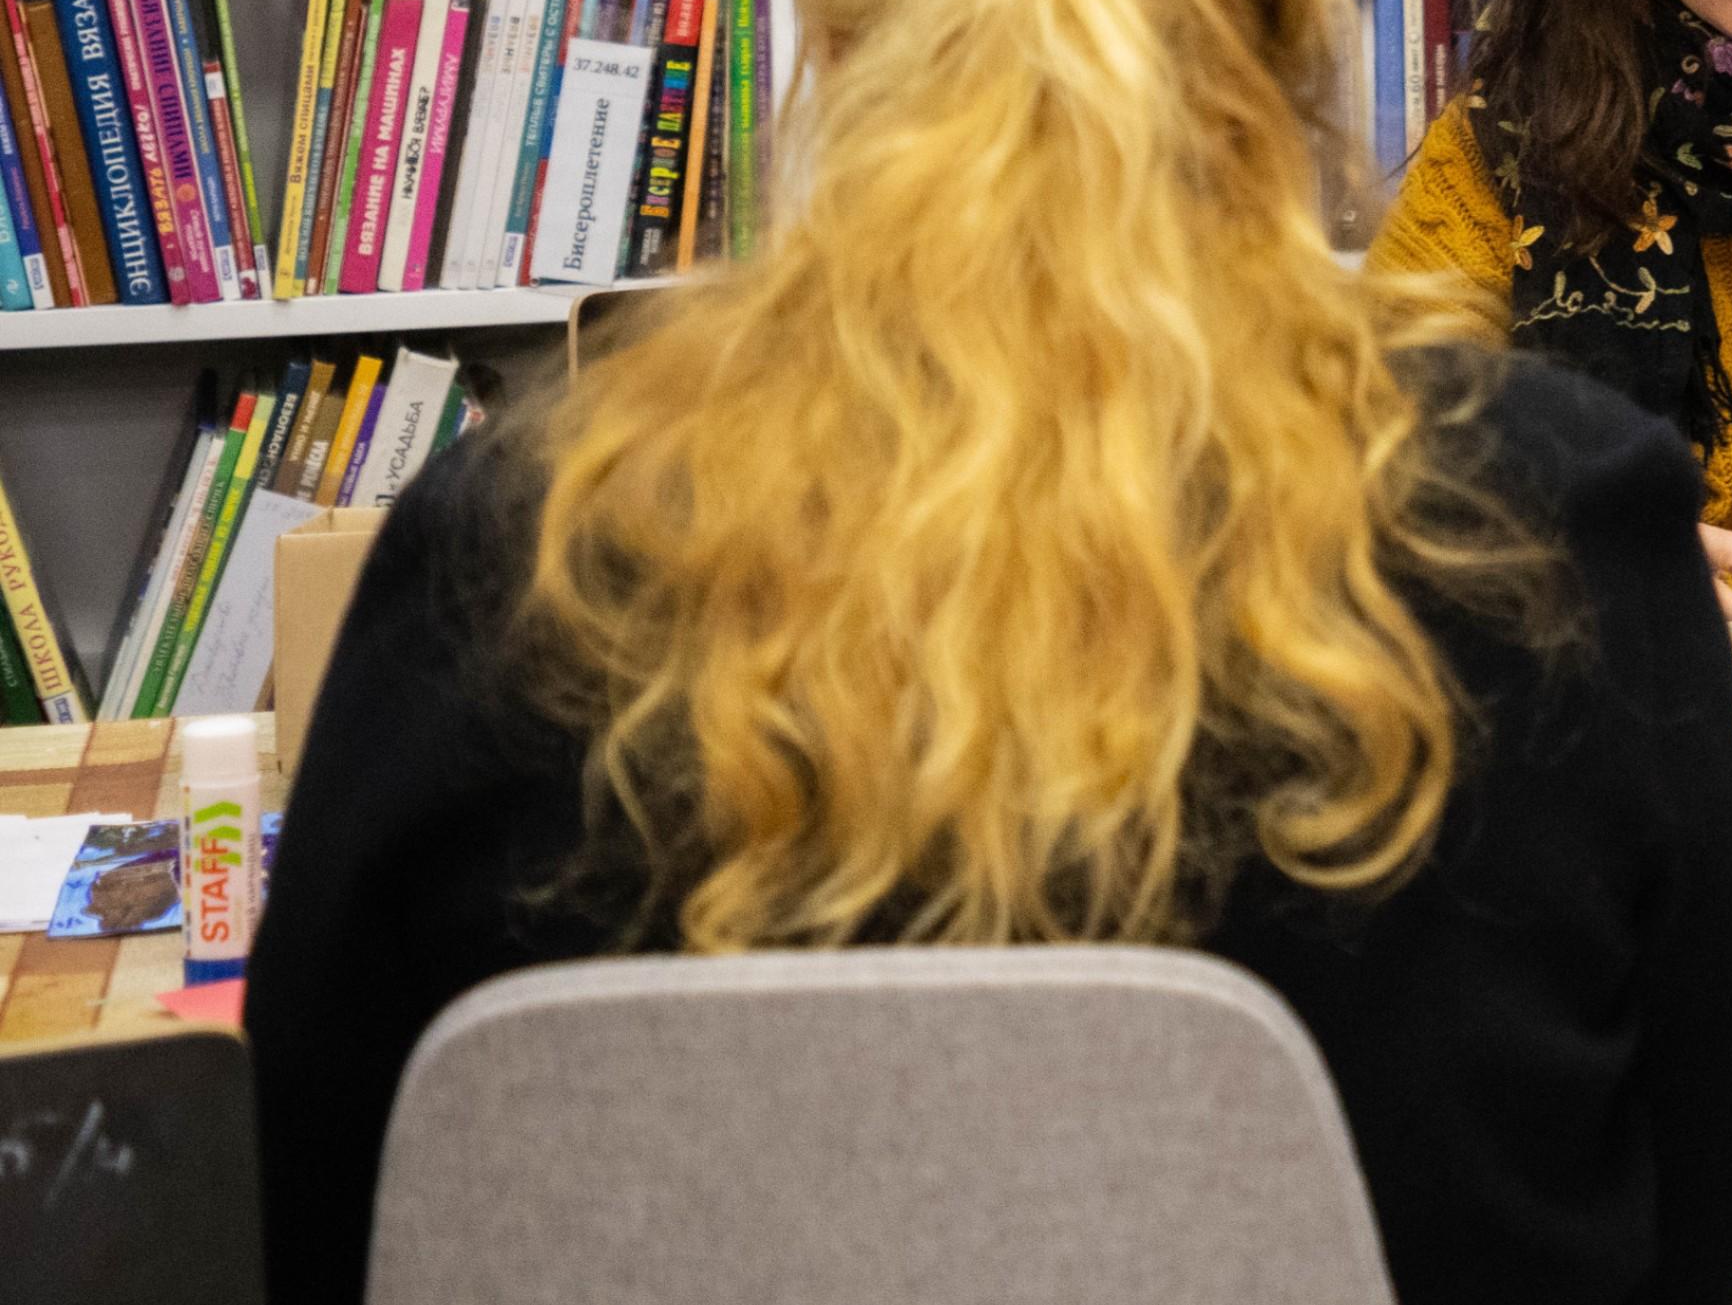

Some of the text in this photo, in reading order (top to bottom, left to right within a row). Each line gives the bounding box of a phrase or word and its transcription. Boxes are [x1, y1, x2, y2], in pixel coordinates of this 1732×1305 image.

[288, 63, 315, 184] Вяжем спицами
[571, 55, 641, 79] 37.248.42
[88, 73, 152, 296] ЭНЦИКЛОПЕДИЯ
[358, 47, 405, 256] ВЯЗАНИЕ НА МАШИНАХ
[563, 97, 611, 271] Бисероплетение
[20, 599, 63, 693] ШКОЛА
[199, 837, 230, 944] STAFF
